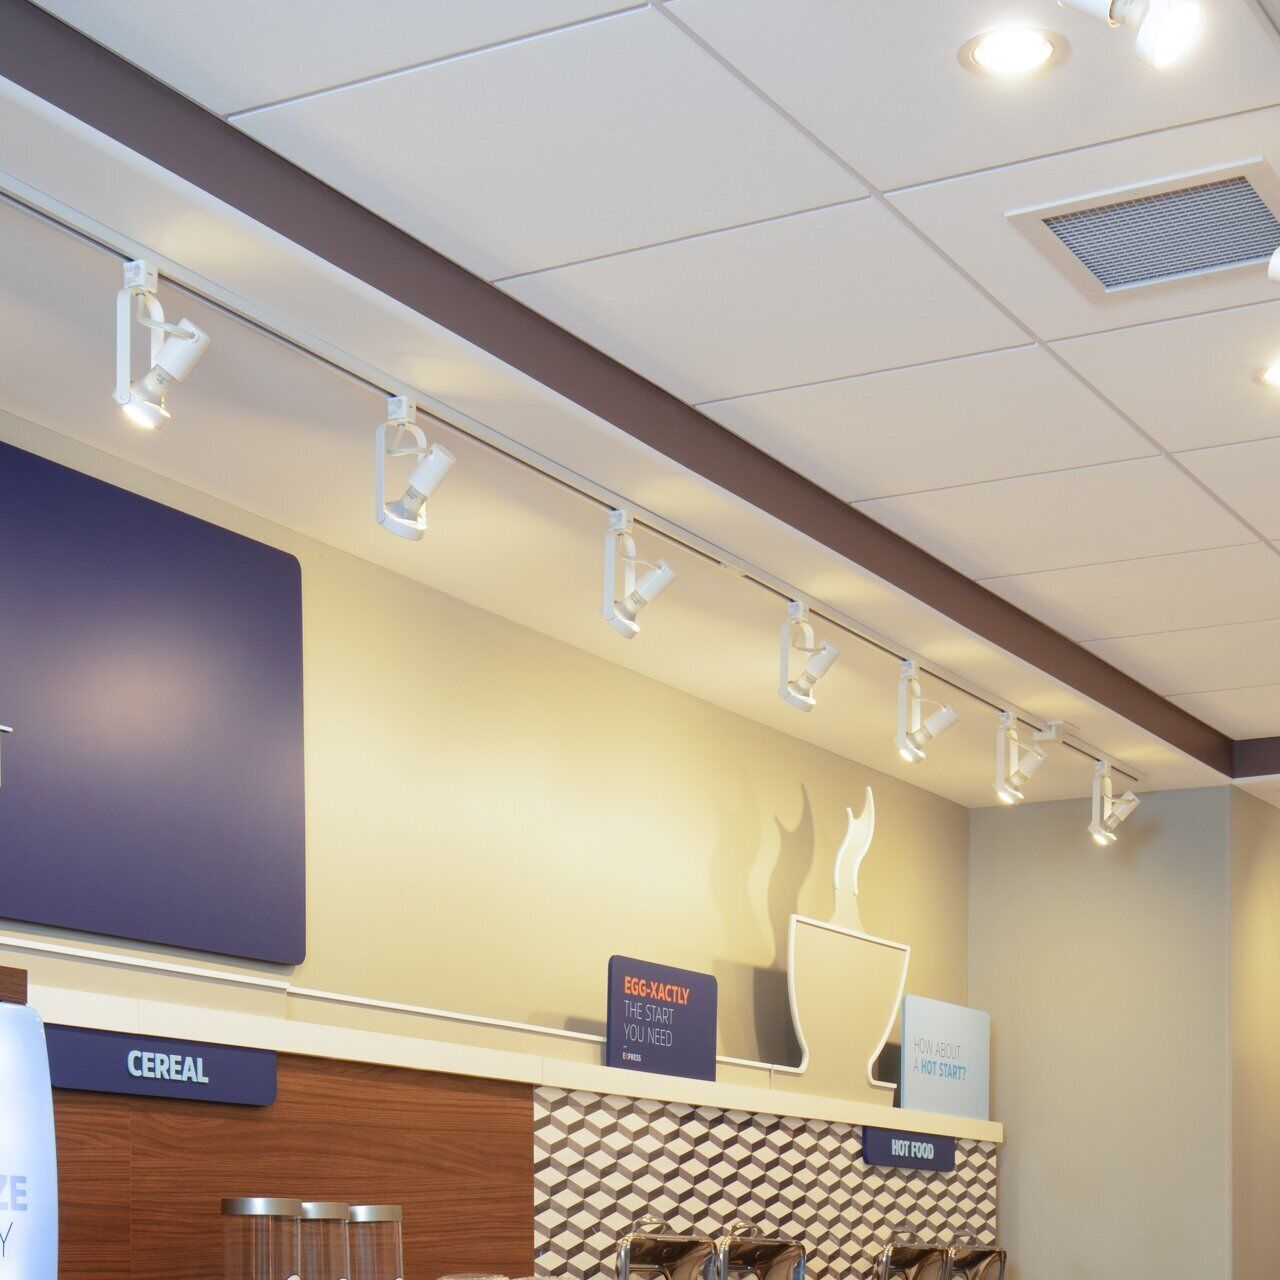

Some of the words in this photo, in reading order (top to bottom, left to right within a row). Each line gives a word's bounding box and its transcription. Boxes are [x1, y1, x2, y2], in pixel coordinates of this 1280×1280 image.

[624, 976, 690, 1005] EGG-XACTLY
[624, 1000, 642, 1020] THE
[645, 1004, 674, 1024] START
[624, 1023, 644, 1043] YOU
[647, 1028, 673, 1046] NEED
[622, 1051, 641, 1062] EXPRESS
[913, 1037, 934, 1055] HOW
[935, 1041, 961, 1060] ABOUT
[127, 1050, 209, 1083] CEREAL
[913, 1059, 920, 1072] A
[921, 1061, 938, 1076] HOT
[939, 1063, 967, 1081] START?
[891, 1139, 910, 1157] HOT
[911, 1141, 934, 1160] FOOD
